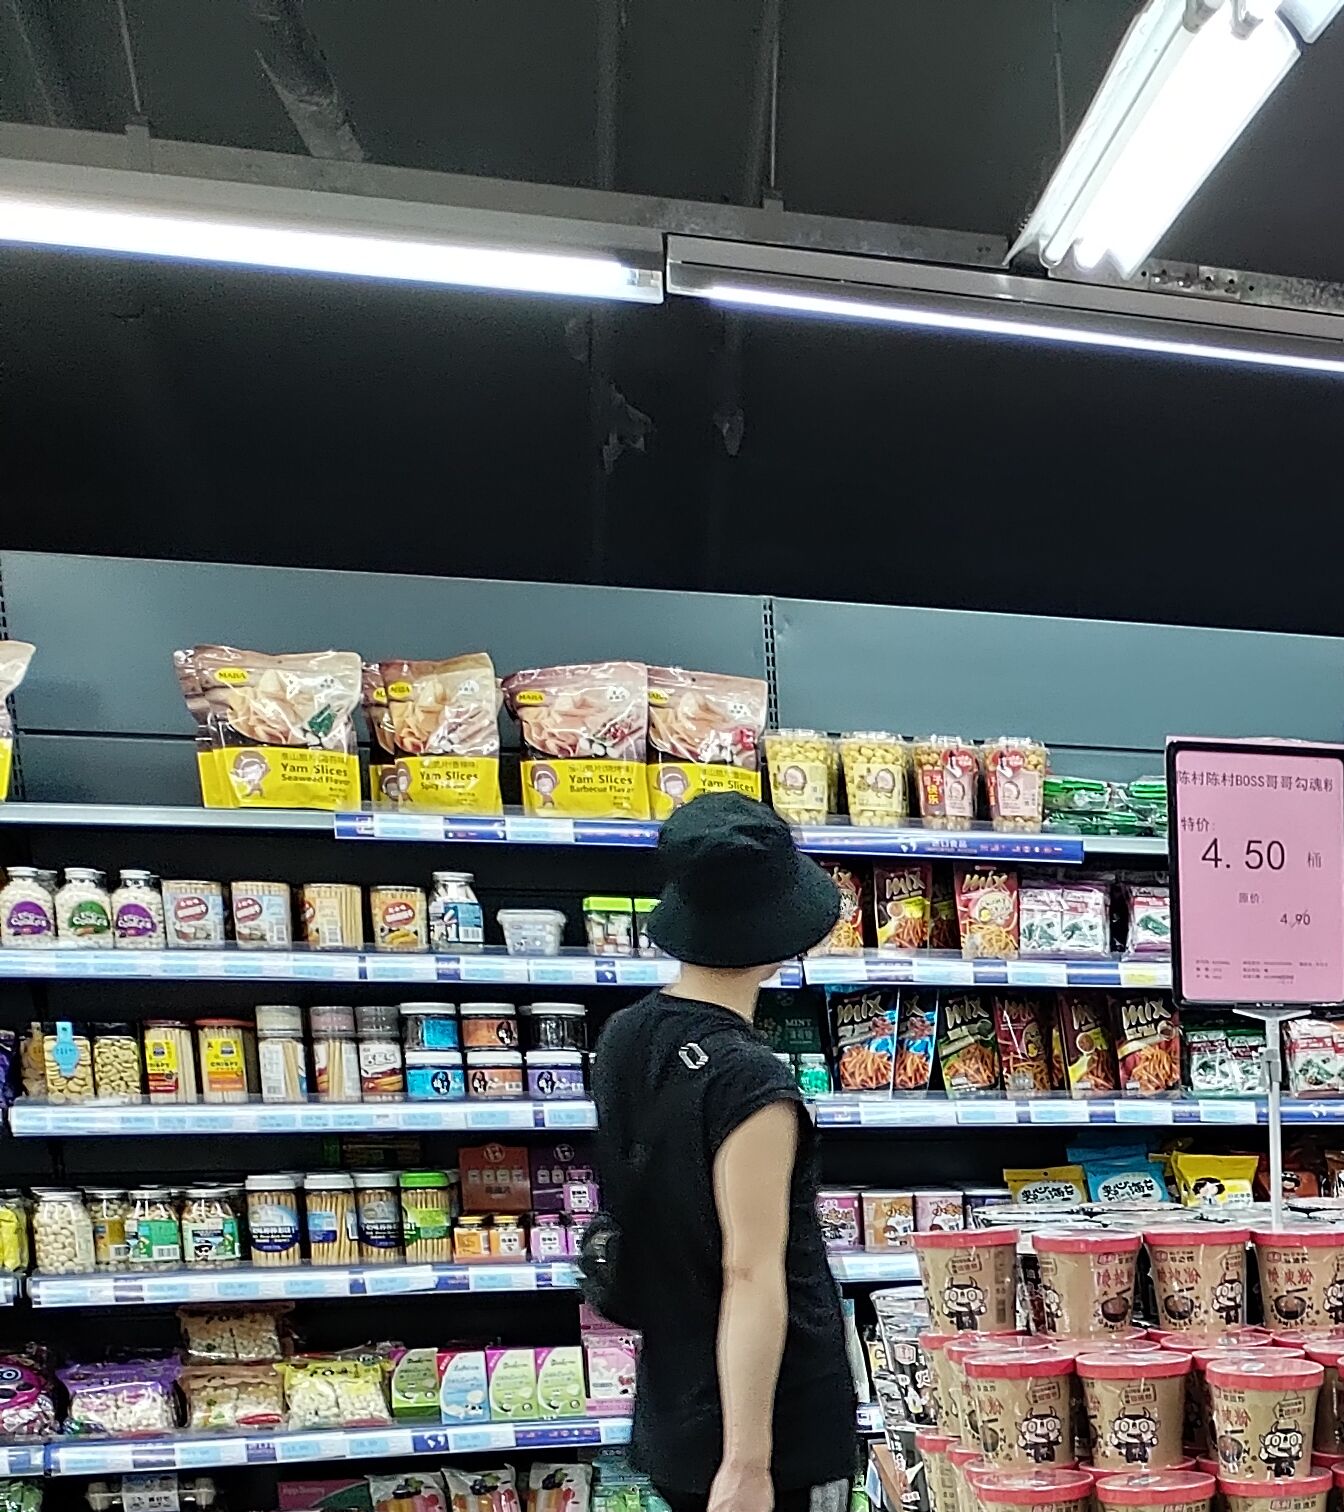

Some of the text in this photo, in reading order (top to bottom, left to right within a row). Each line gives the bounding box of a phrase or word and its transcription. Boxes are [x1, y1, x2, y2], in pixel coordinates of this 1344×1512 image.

[281, 763, 348, 777] Yam Slices
[420, 771, 478, 781] Yam Slices
[569, 774, 633, 785] Yam Slices
[701, 778, 755, 792] Yam Slices
[1201, 838, 1286, 870] 4.50
